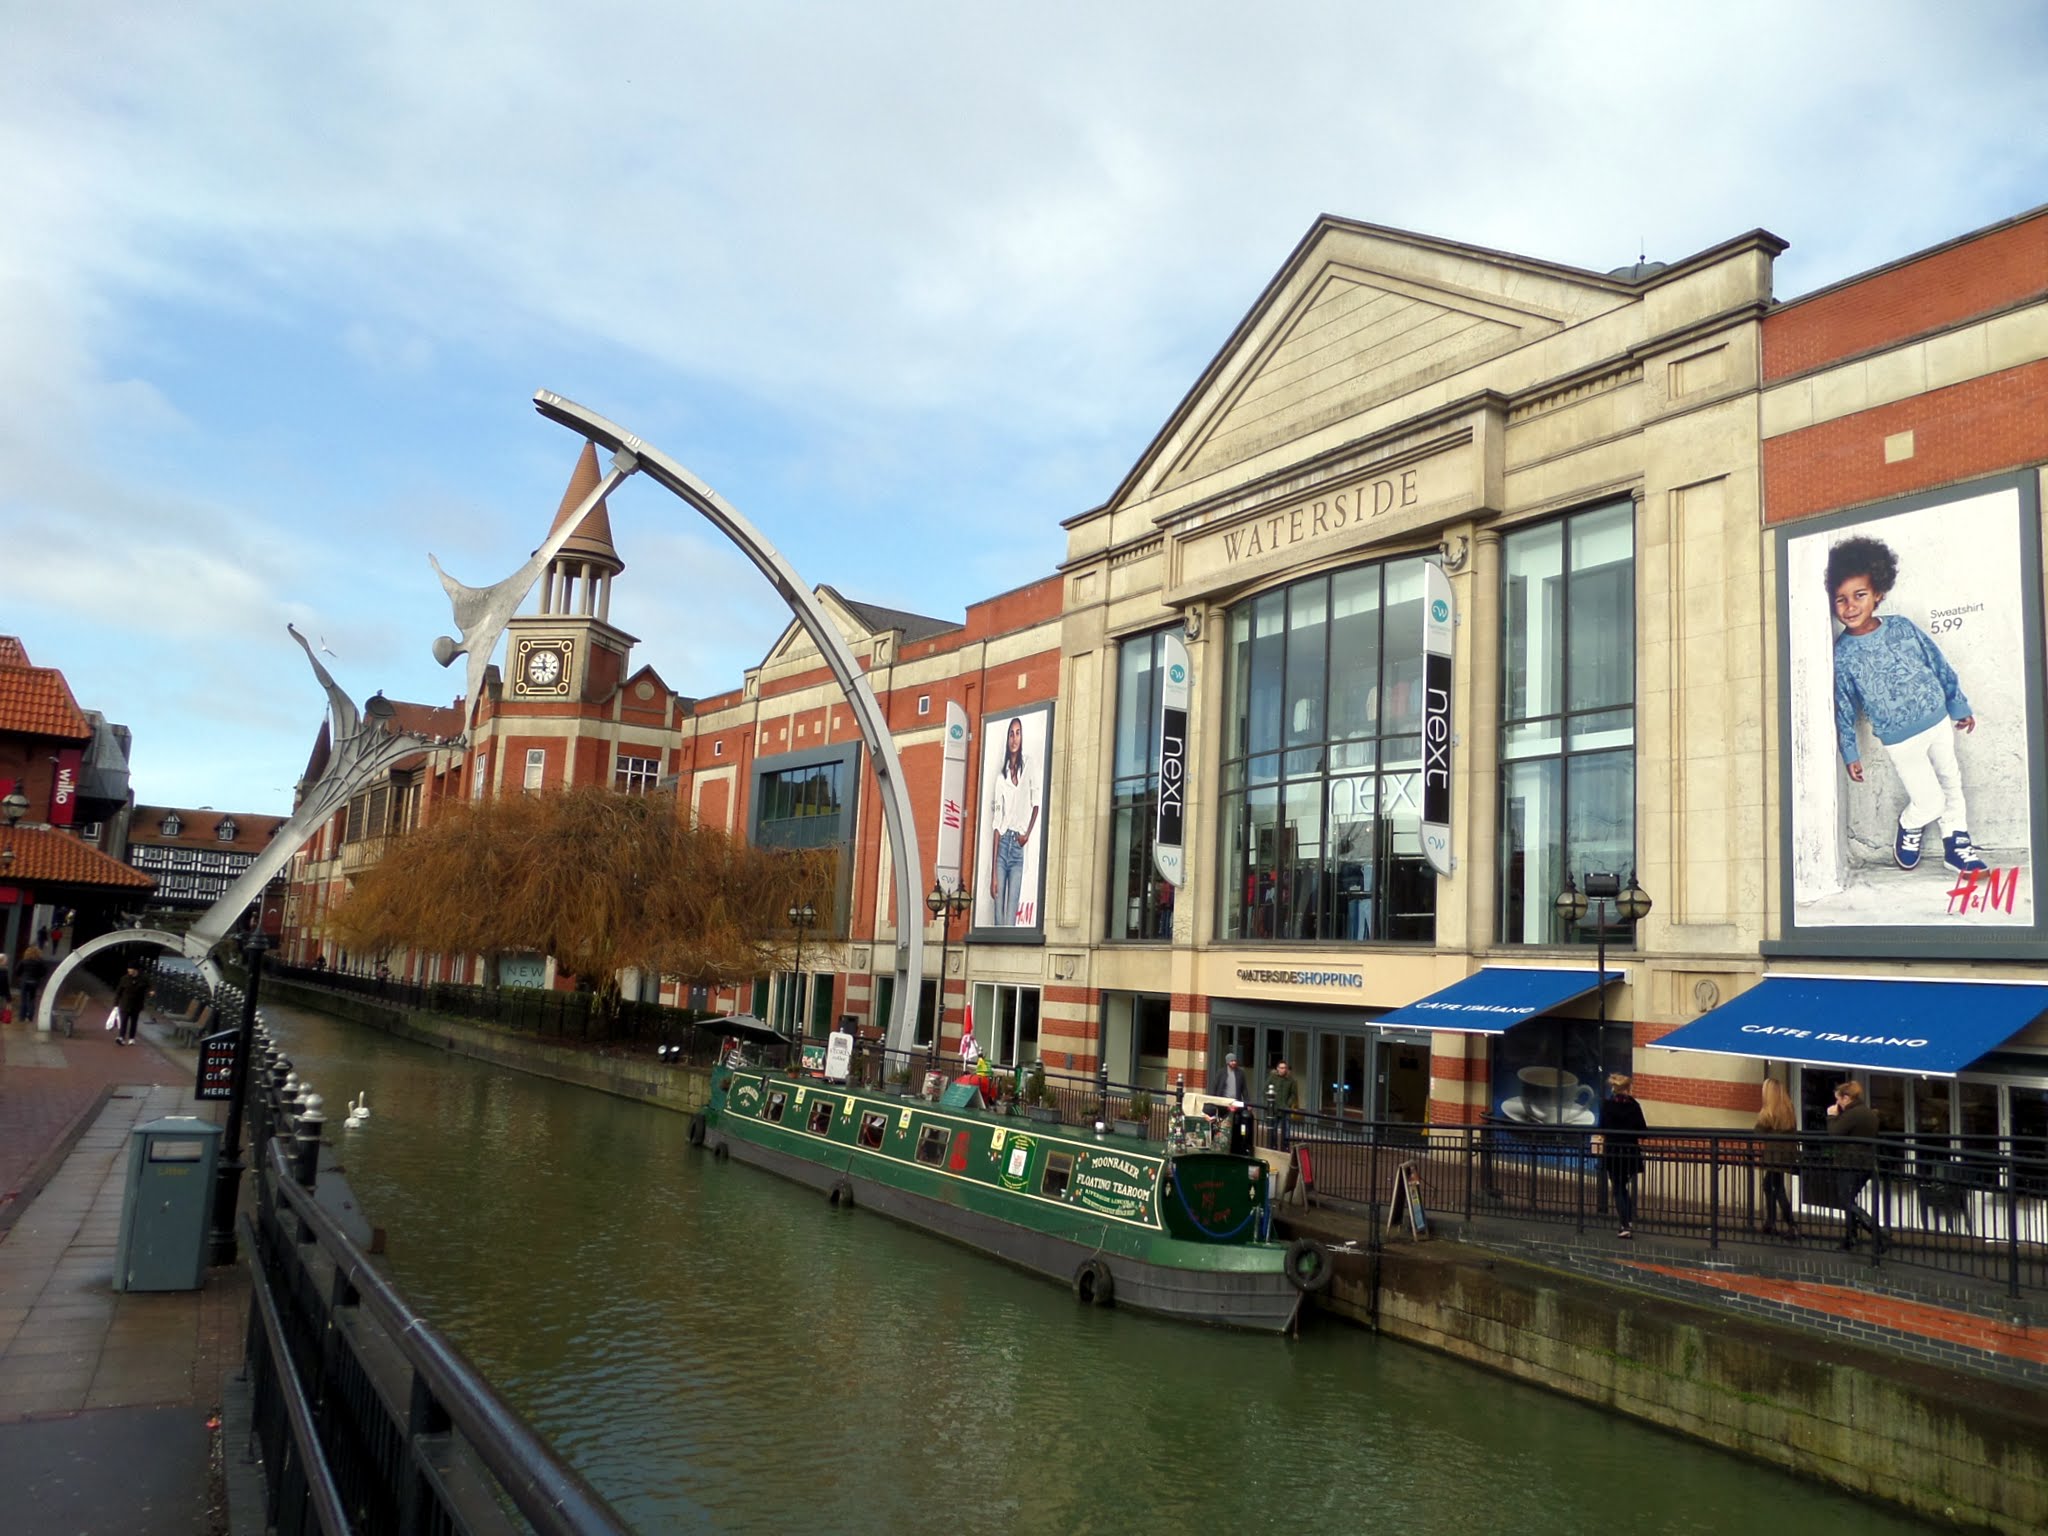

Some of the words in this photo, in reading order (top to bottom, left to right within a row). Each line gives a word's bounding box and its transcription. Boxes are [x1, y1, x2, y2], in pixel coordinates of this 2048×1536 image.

[1223, 470, 1418, 563] WATERSIDE
[1930, 603, 1984, 619] Sweatshirt
[1931, 617, 1963, 634] 5.99
[1425, 688, 1448, 789] next
[56, 769, 75, 804] wilko
[1162, 736, 1183, 817] next
[1329, 773, 1418, 815] nex
[1946, 867, 2019, 915] H&M
[507, 966, 544, 977] NEW
[1416, 1002, 1461, 1010] CAFFE
[1461, 1005, 1535, 1014] ITALIANO
[209, 1042, 236, 1050] CITY
[1741, 1025, 1812, 1038] CAFFE
[1815, 1033, 1928, 1047] ITALIANO
[207, 1057, 234, 1065] CITY
[203, 1087, 231, 1095] HERE
[1091, 1156, 1140, 1179] MOONRAKER
[1076, 1173, 1112, 1191] FLOATING
[1113, 1181, 1150, 1202] TEAROOM
